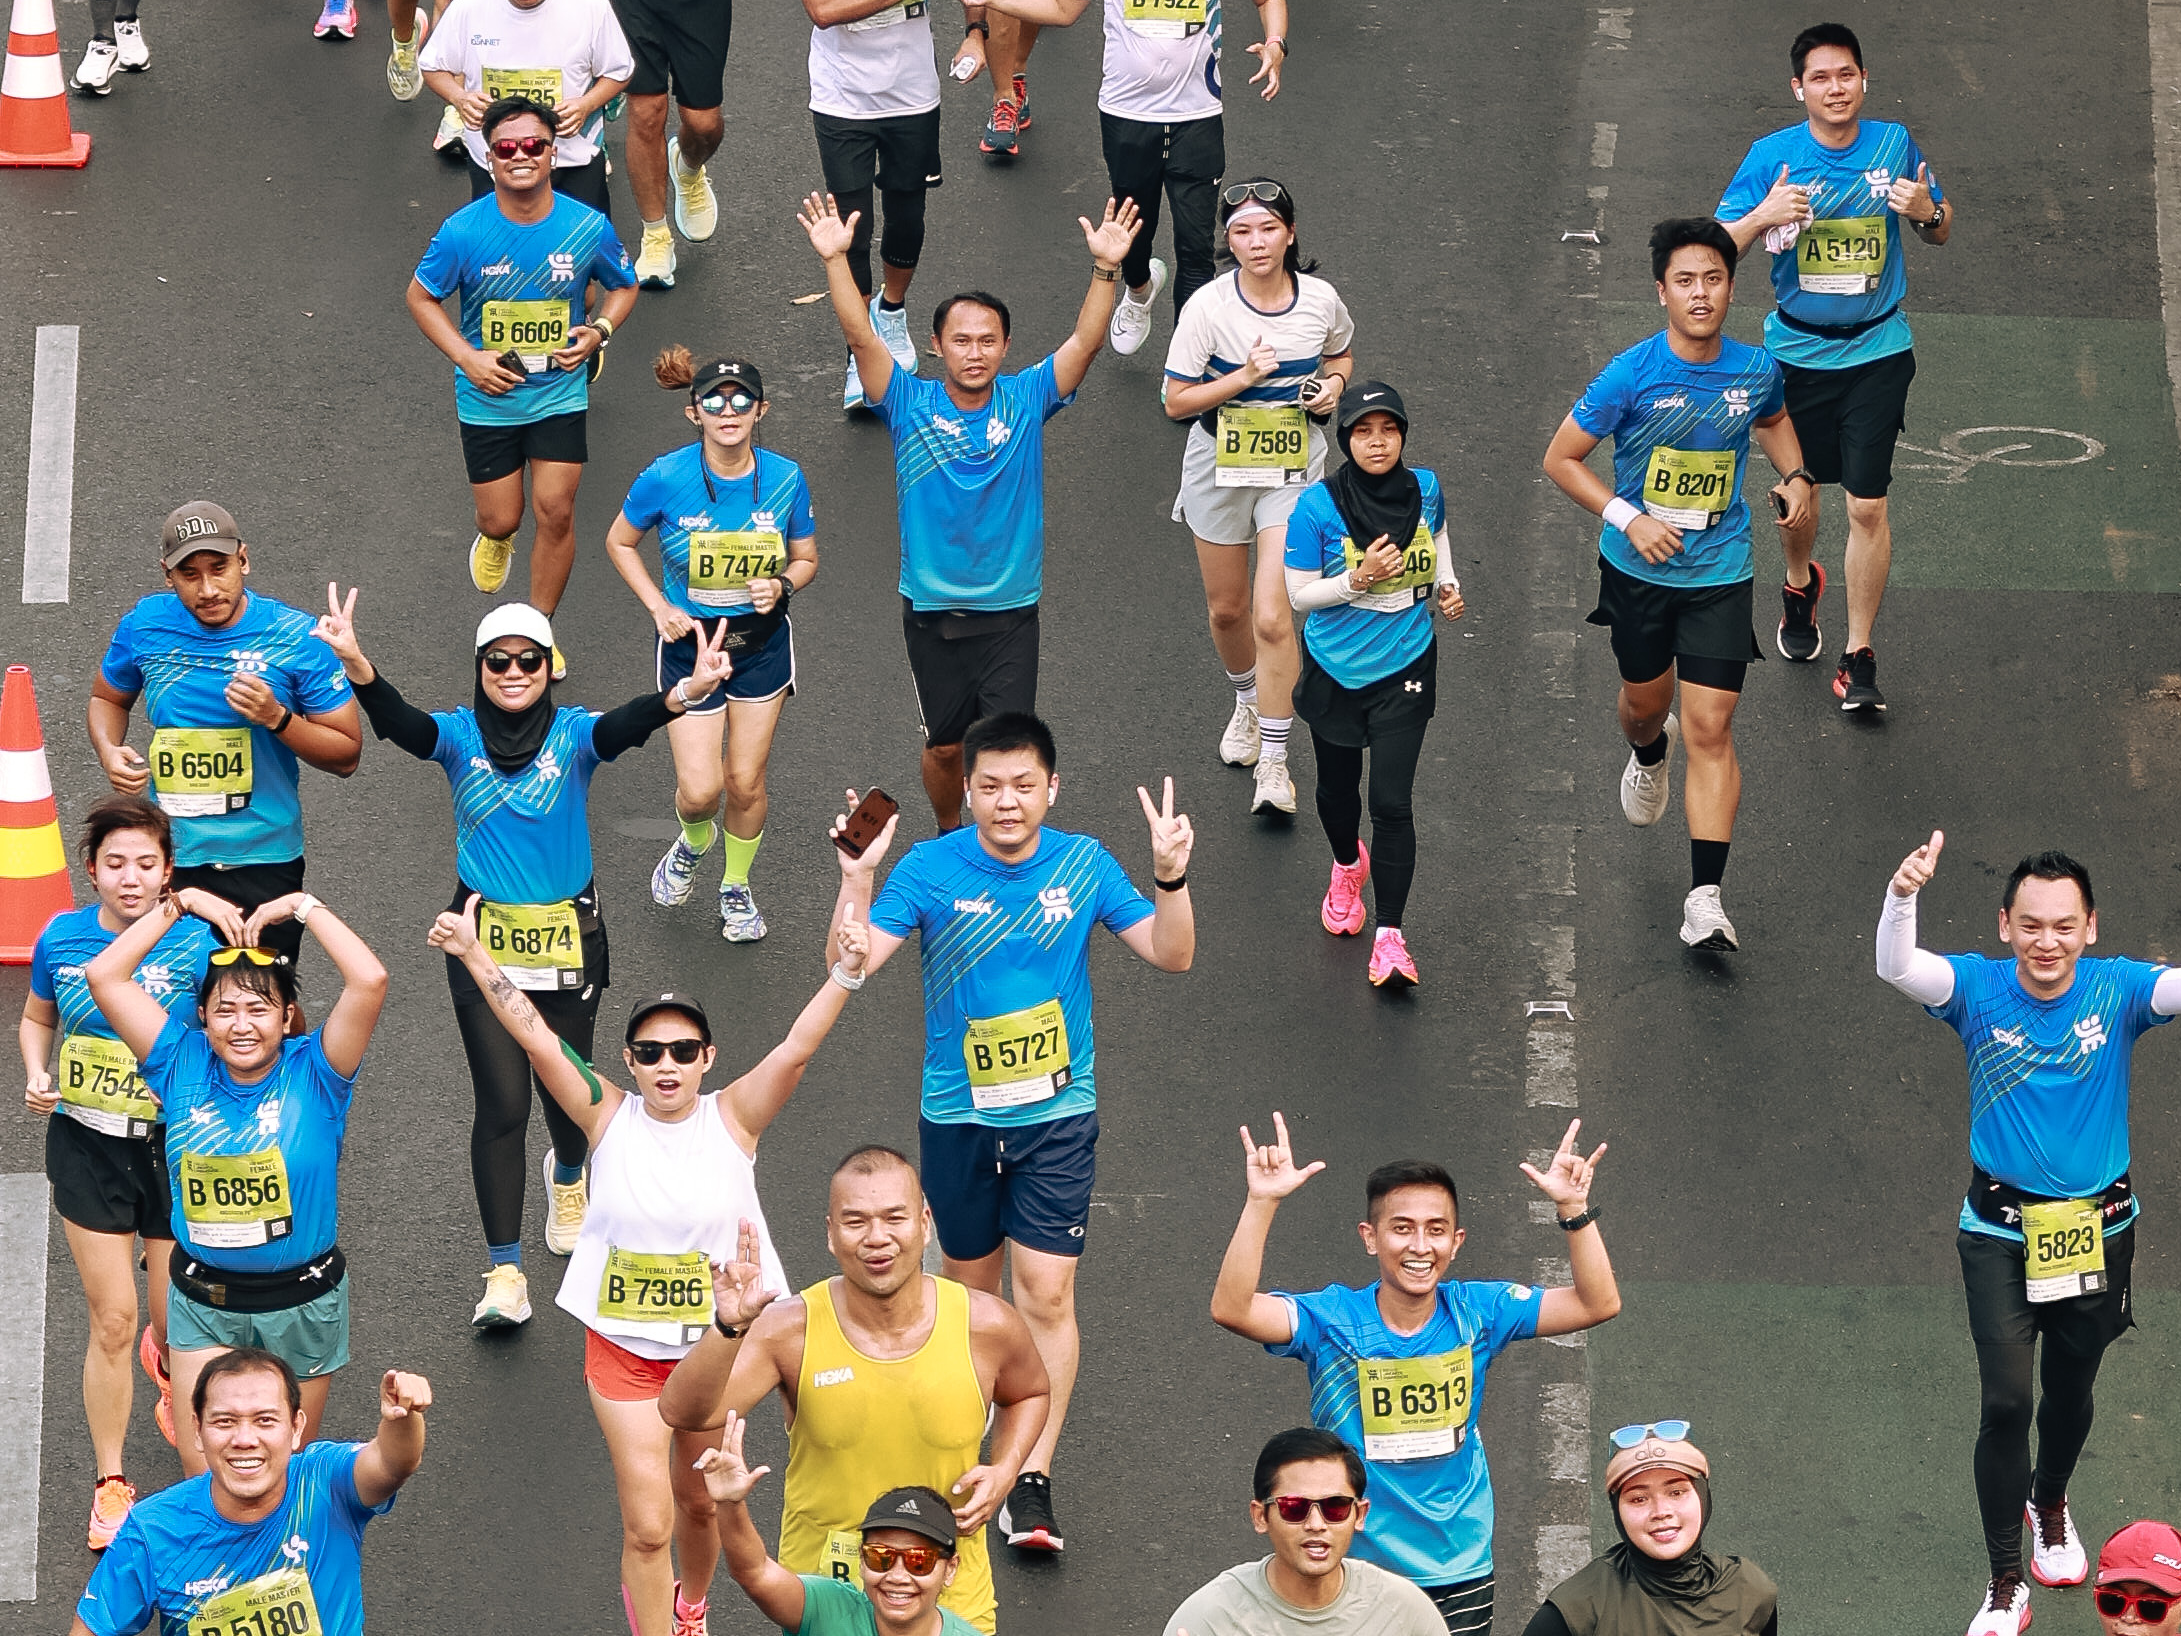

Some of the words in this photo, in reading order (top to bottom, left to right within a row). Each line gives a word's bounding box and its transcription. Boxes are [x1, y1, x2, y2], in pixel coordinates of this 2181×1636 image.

[1805, 239, 1822, 262] A
[1826, 237, 1881, 261] 5120
[481, 263, 511, 276] HOKA
[490, 321, 505, 342] B
[511, 320, 563, 343] 6609
[1225, 430, 1241, 453] B
[1247, 430, 1302, 454] 7589
[1653, 468, 1672, 492] B
[1675, 472, 1728, 497] 8201
[678, 516, 712, 528] HOKA
[699, 554, 715, 578] B
[721, 554, 777, 578] 7474
[1405, 548, 1432, 574] 46
[158, 751, 174, 778] B
[182, 751, 244, 779] 6504
[954, 899, 992, 914] HOKA
[490, 925, 505, 951] B
[511, 924, 574, 955] 6874
[1041, 1014, 1057, 1026] MALE
[102, 1053, 127, 1065] FEMALE
[973, 1044, 993, 1071] B
[998, 1025, 1059, 1068] 5727
[69, 1059, 85, 1088] B
[188, 1178, 206, 1207] B
[213, 1175, 281, 1207] 6856
[2037, 1225, 2095, 1263] 5823
[645, 1266, 673, 1275] FEMALE
[675, 1265, 704, 1275] MASTER
[608, 1274, 625, 1303] B
[634, 1278, 703, 1307] 7386
[814, 1366, 855, 1388] HOKA
[1372, 1387, 1393, 1417] B
[1400, 1376, 1467, 1416] 6313
[832, 1561, 850, 1583] B
[245, 1595, 267, 1607] MALE
[268, 1586, 301, 1602] MASTER
[230, 1601, 310, 1636] 5180
